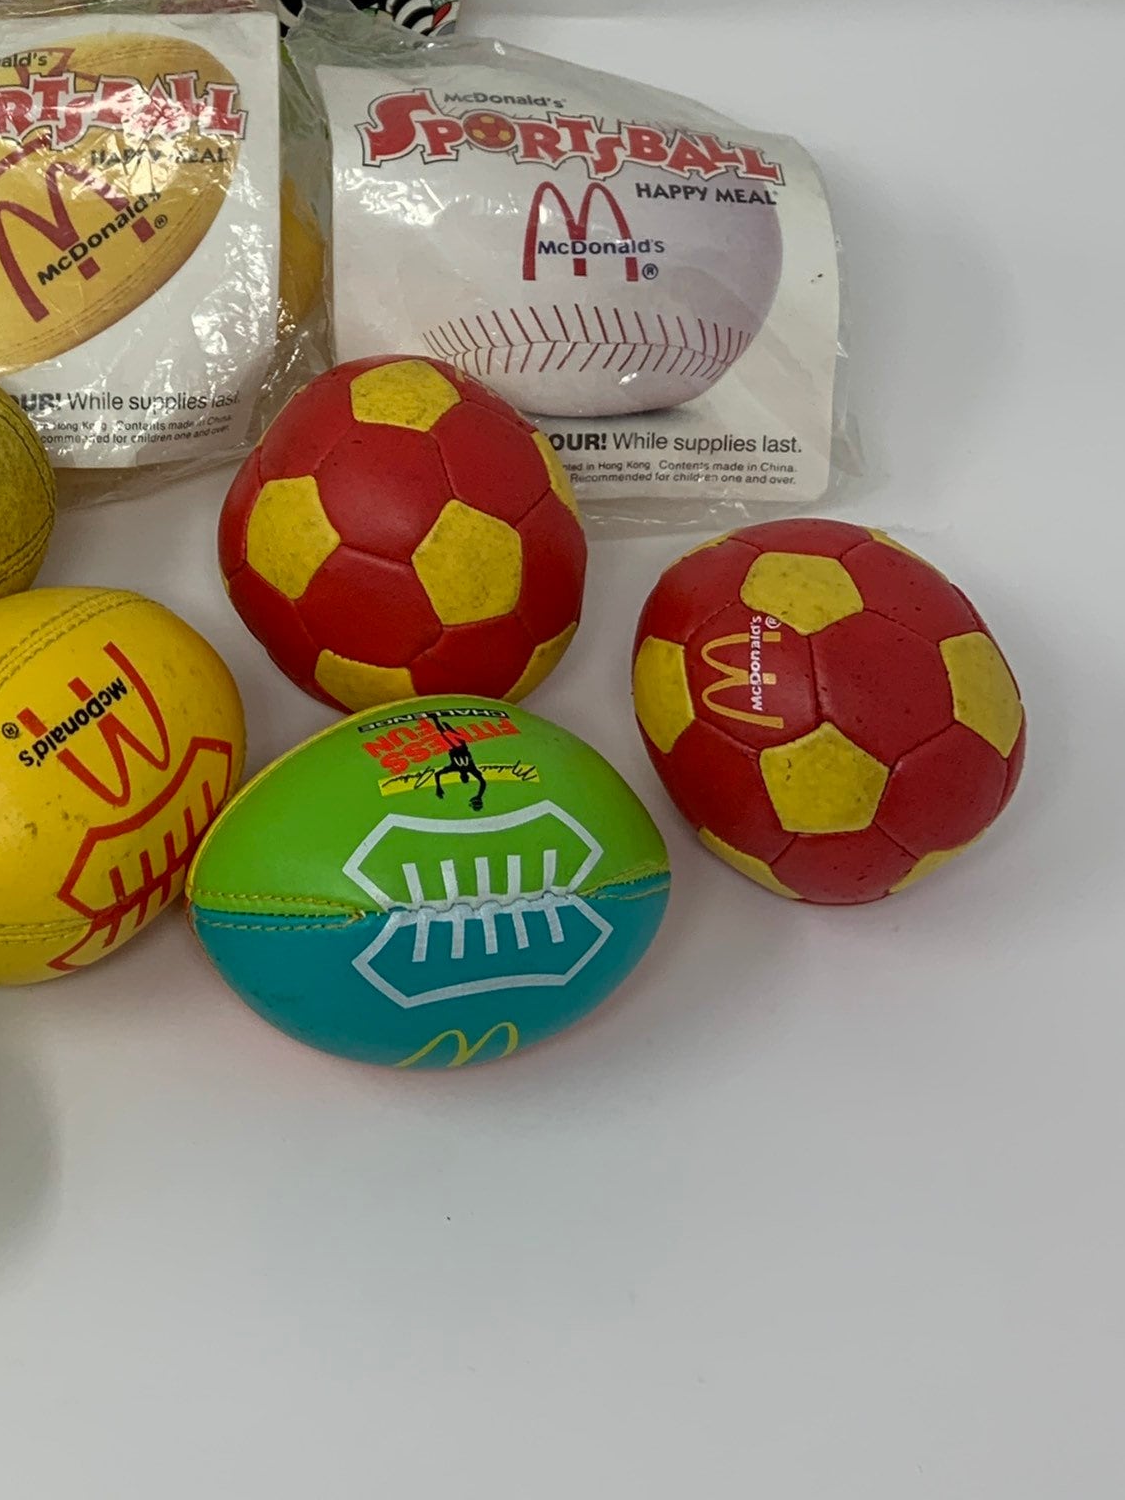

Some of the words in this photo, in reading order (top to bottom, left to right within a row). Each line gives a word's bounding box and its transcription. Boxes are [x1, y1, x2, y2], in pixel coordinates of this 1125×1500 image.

[444, 92, 564, 109] McDonald's
[354, 87, 786, 186] SPORTSBALL
[635, 182, 708, 202] HAPPY
[538, 239, 665, 256] McDonald's
[67, 391, 123, 410] While
[128, 392, 207, 414] supplies
[112, 433, 126, 444] for
[174, 432, 191, 441] one
[193, 427, 210, 438] and
[548, 433, 607, 451] OUR!
[613, 432, 668, 450] While
[673, 435, 757, 454] supplies
[762, 435, 802, 453] last.
[586, 462, 594, 471] in
[598, 461, 623, 472] Hong
[712, 462, 744, 472] made
[747, 462, 757, 472] in
[570, 473, 653, 483] Recommended
[655, 473, 670, 482] for
[721, 475, 742, 483] one
[745, 474, 766, 484] and
[750, 615, 763, 711] McDonald's
[18, 676, 128, 767] McDonald's
[363, 718, 437, 758] FUN
[379, 718, 522, 776] FITNESS
